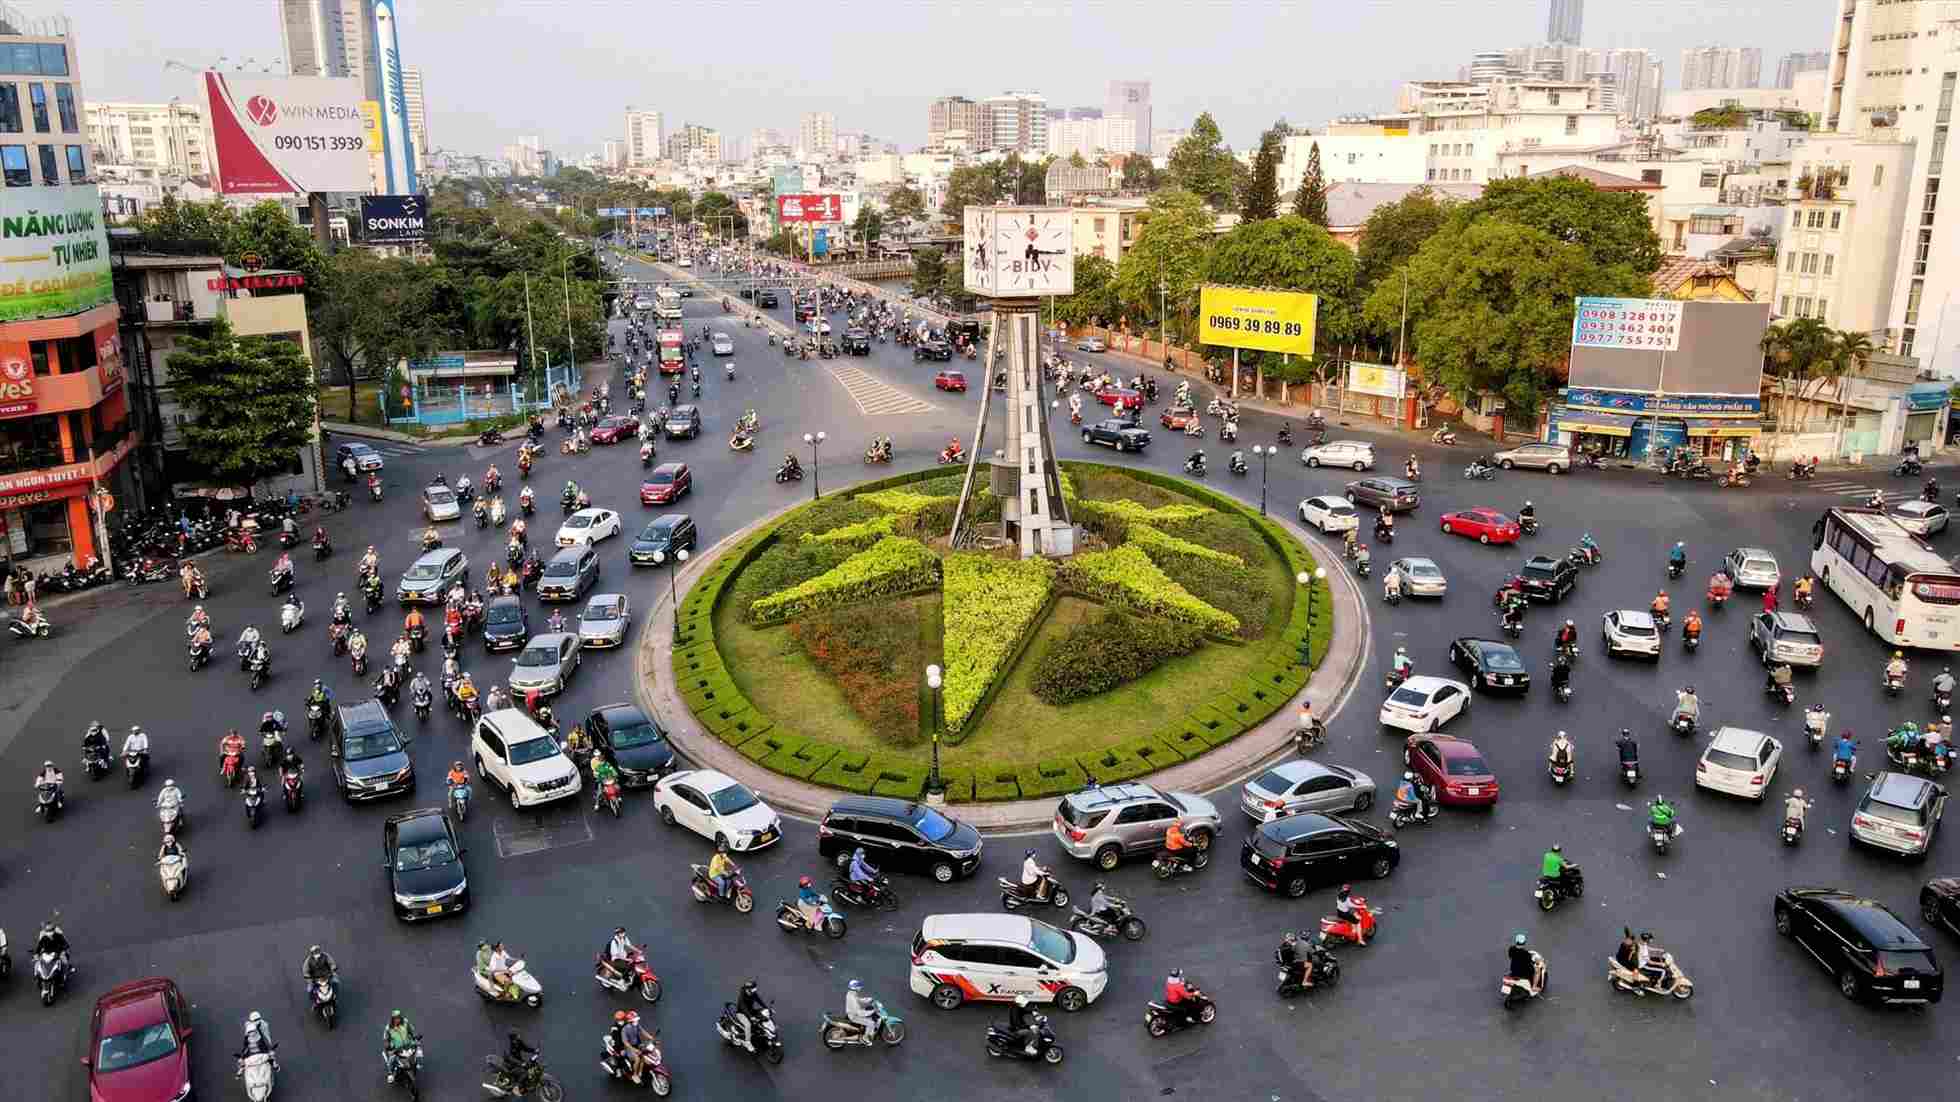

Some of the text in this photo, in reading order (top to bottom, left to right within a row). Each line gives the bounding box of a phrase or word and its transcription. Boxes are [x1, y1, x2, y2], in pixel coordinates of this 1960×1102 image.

[282, 104, 313, 119] WIN
[316, 106, 360, 120] MEDIA
[275, 136, 363, 150] 090 151 3939
[3, 209, 64, 238] NĂNG
[367, 217, 423, 230] SONKIM
[1012, 260, 1051, 272] BIDV
[1583, 310, 1676, 321] 0908 328 017
[1582, 322, 1674, 334] 0933 462 404
[1619, 335, 1643, 344] 755
